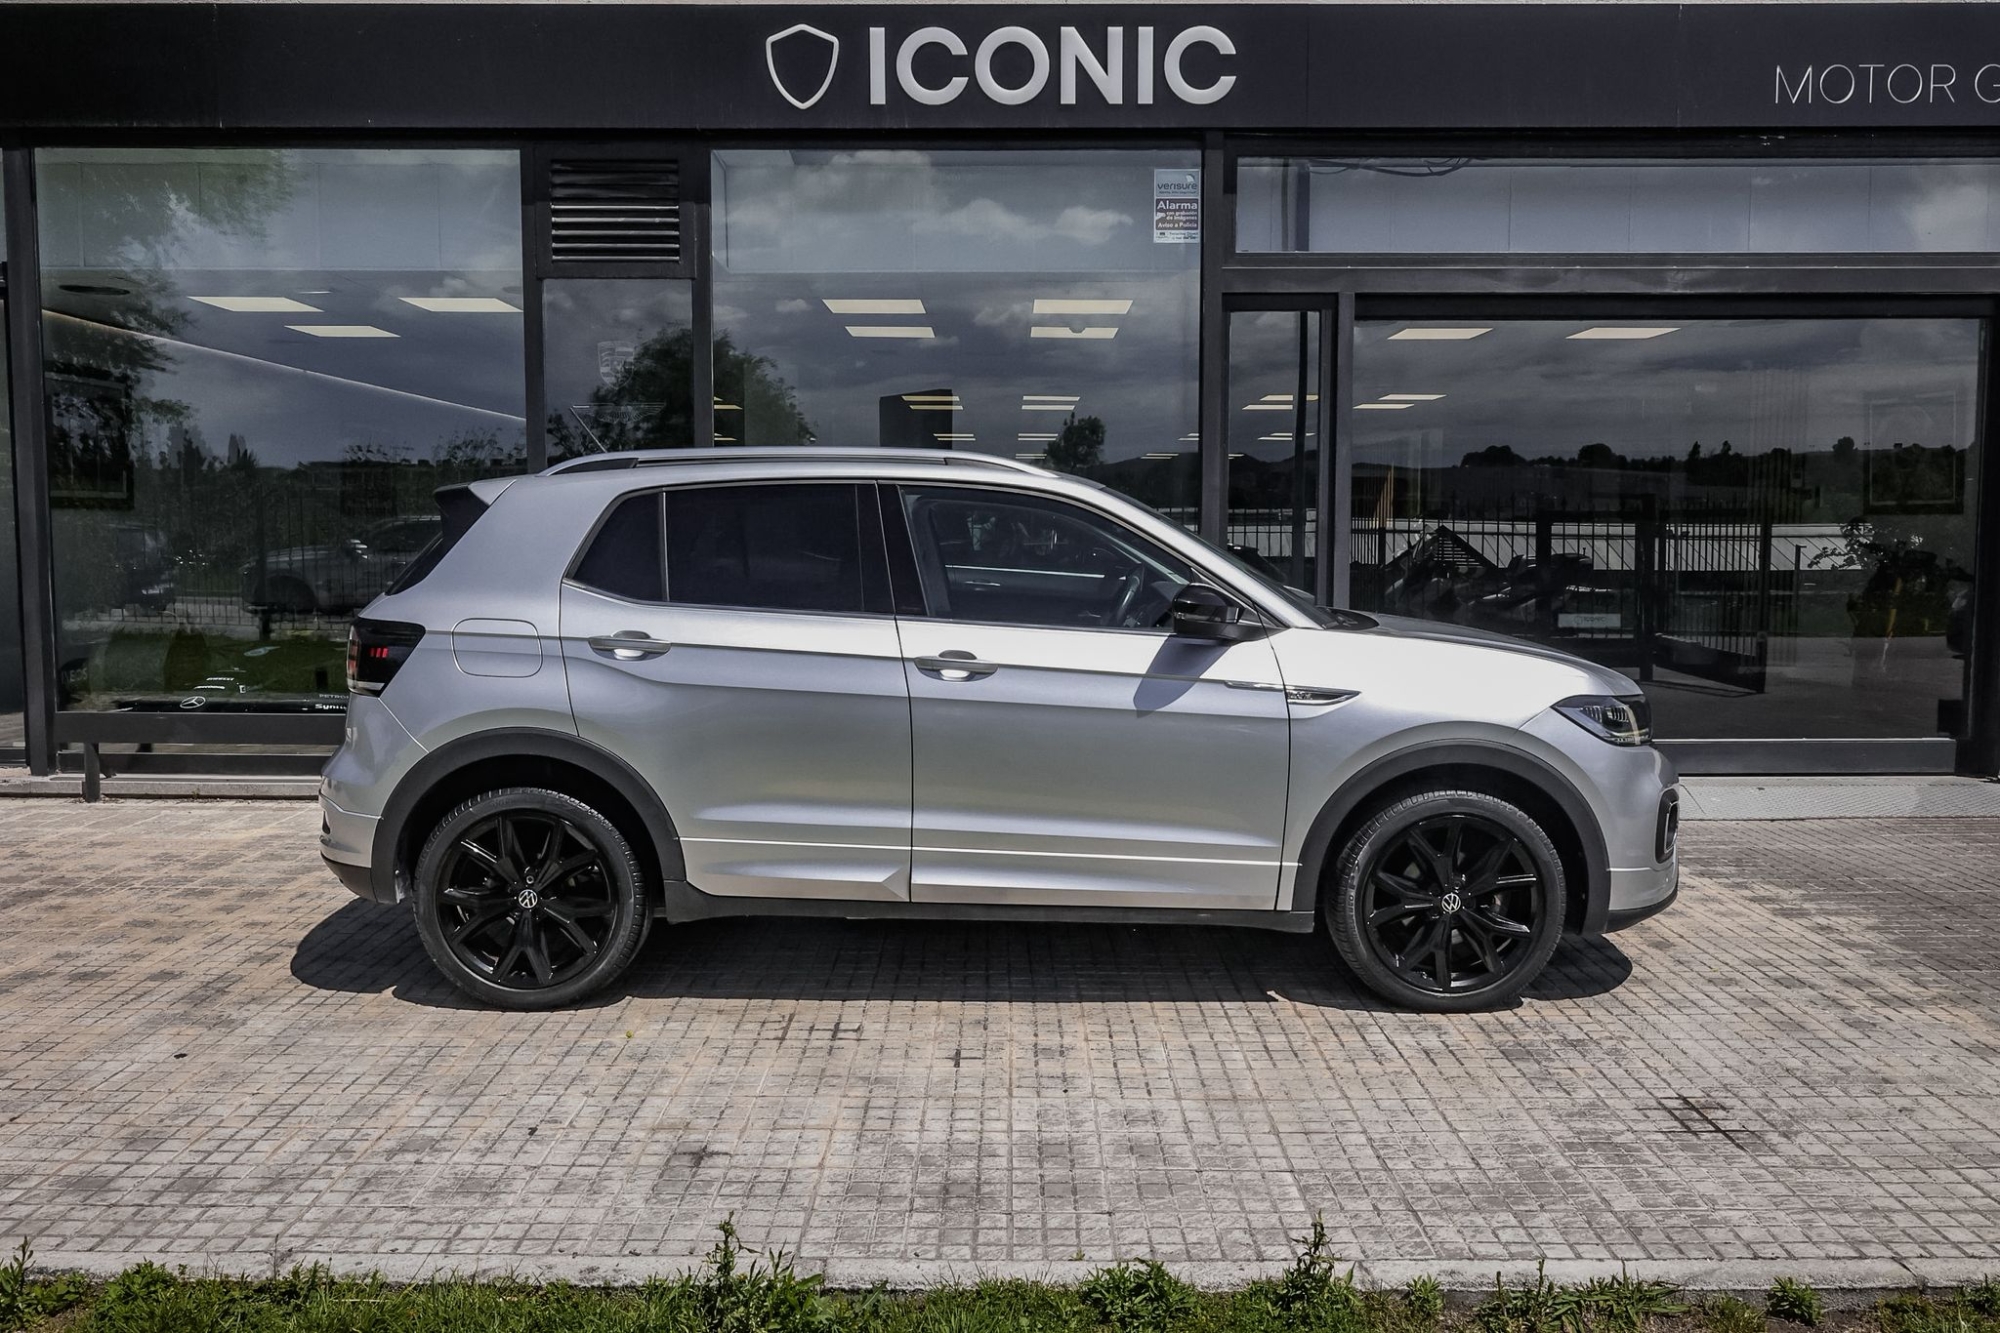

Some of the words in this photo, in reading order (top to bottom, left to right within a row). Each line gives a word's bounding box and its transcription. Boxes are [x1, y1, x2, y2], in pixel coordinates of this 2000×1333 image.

[869, 25, 1237, 105] ICONIC
[1775, 63, 1956, 104] MOTOR
[1157, 182, 1198, 190] verisure
[1157, 200, 1198, 210] Alarma
